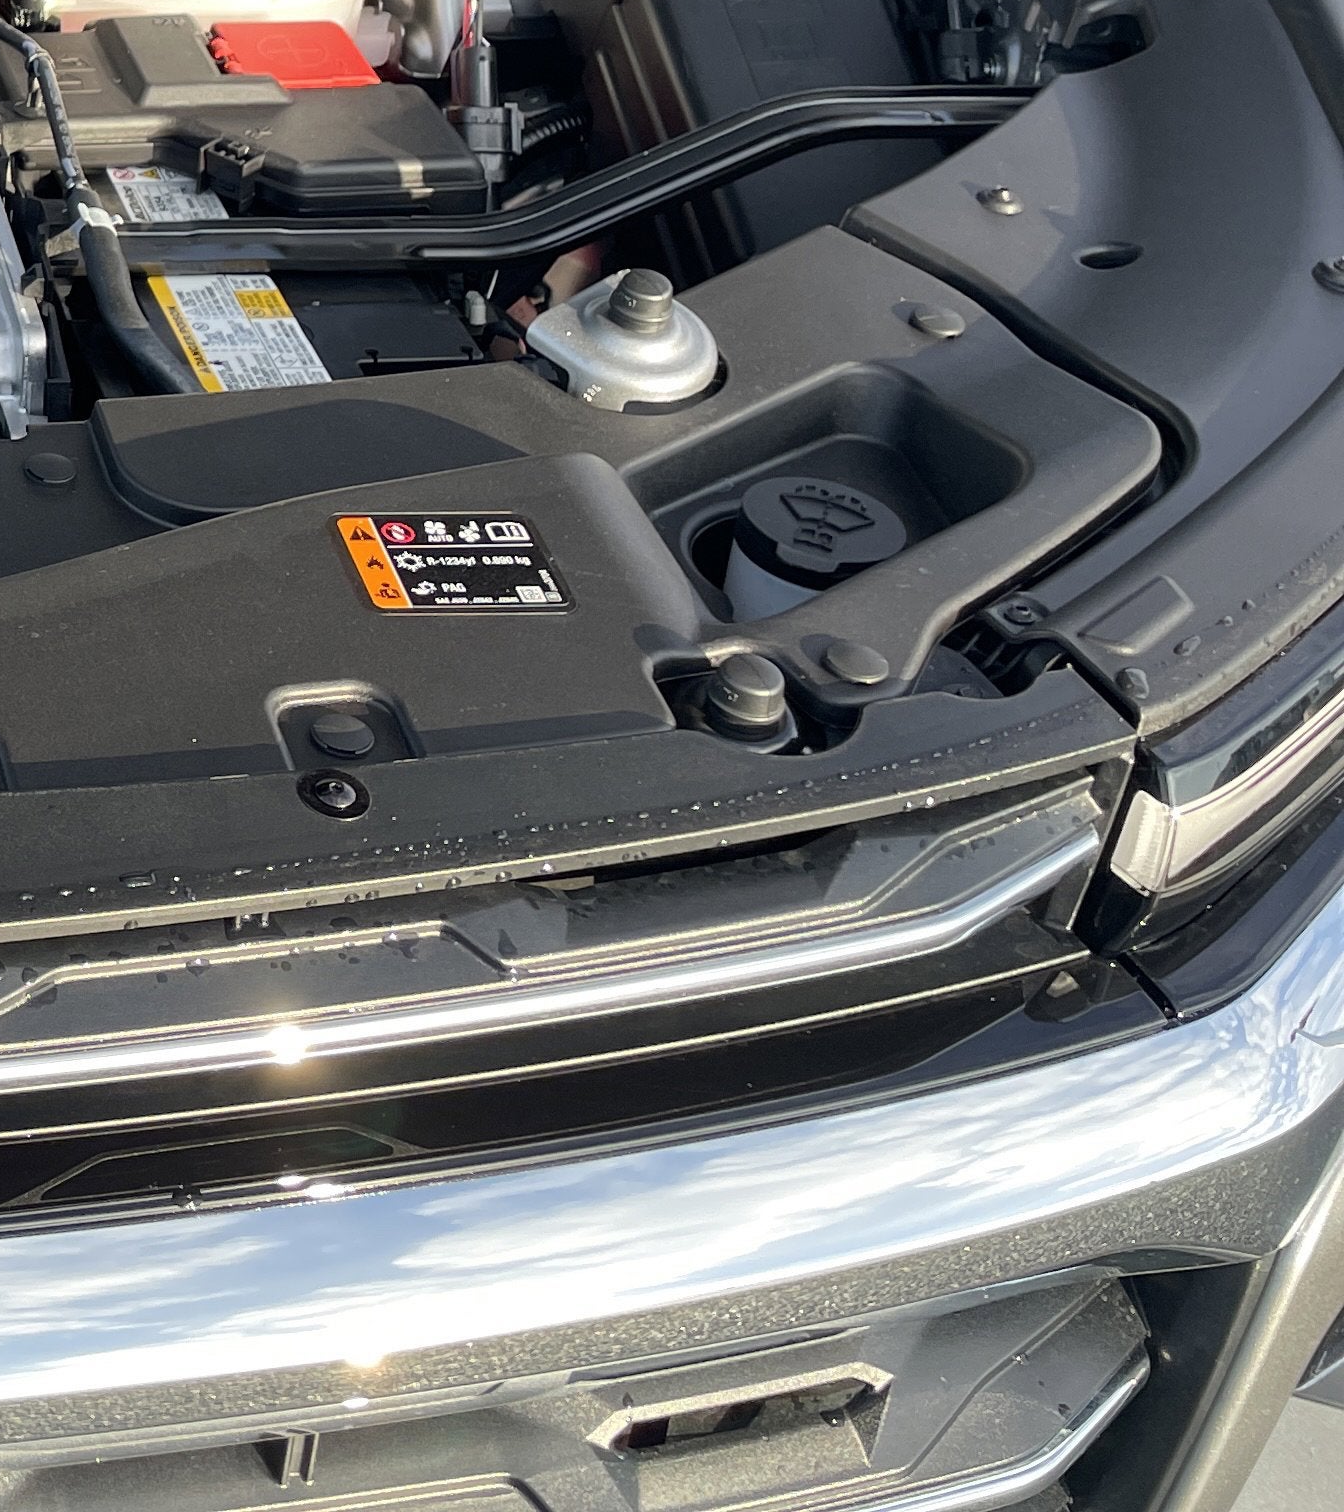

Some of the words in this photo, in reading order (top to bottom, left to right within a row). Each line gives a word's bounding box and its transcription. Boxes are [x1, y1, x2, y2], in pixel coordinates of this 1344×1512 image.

[427, 534, 454, 543] AUTO
[426, 556, 477, 567] R-1234yf
[514, 555, 532, 566] kg
[441, 582, 467, 593] PAG
